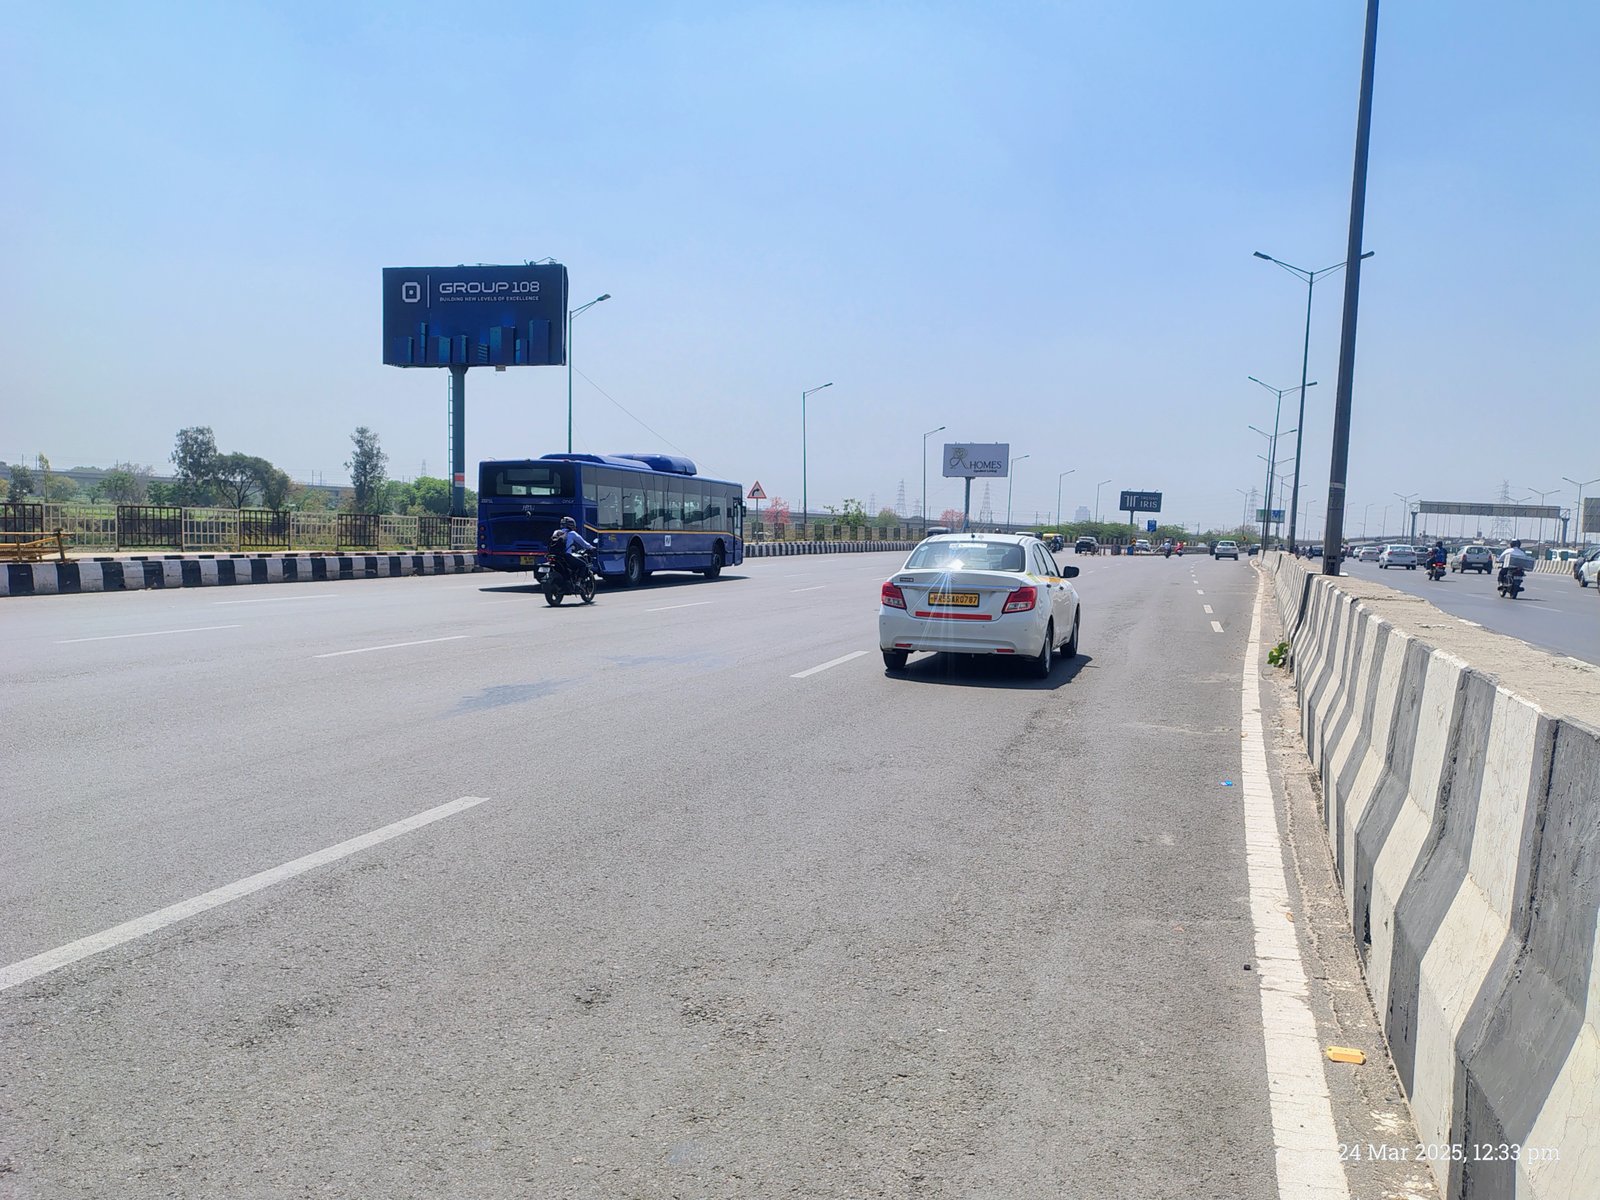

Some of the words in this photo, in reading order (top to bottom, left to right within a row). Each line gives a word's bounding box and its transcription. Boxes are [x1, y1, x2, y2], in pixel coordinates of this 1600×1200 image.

[439, 282, 509, 294] GROUP
[511, 281, 540, 293] 108
[969, 460, 1002, 470] HOMES
[1140, 500, 1158, 509] IRIS
